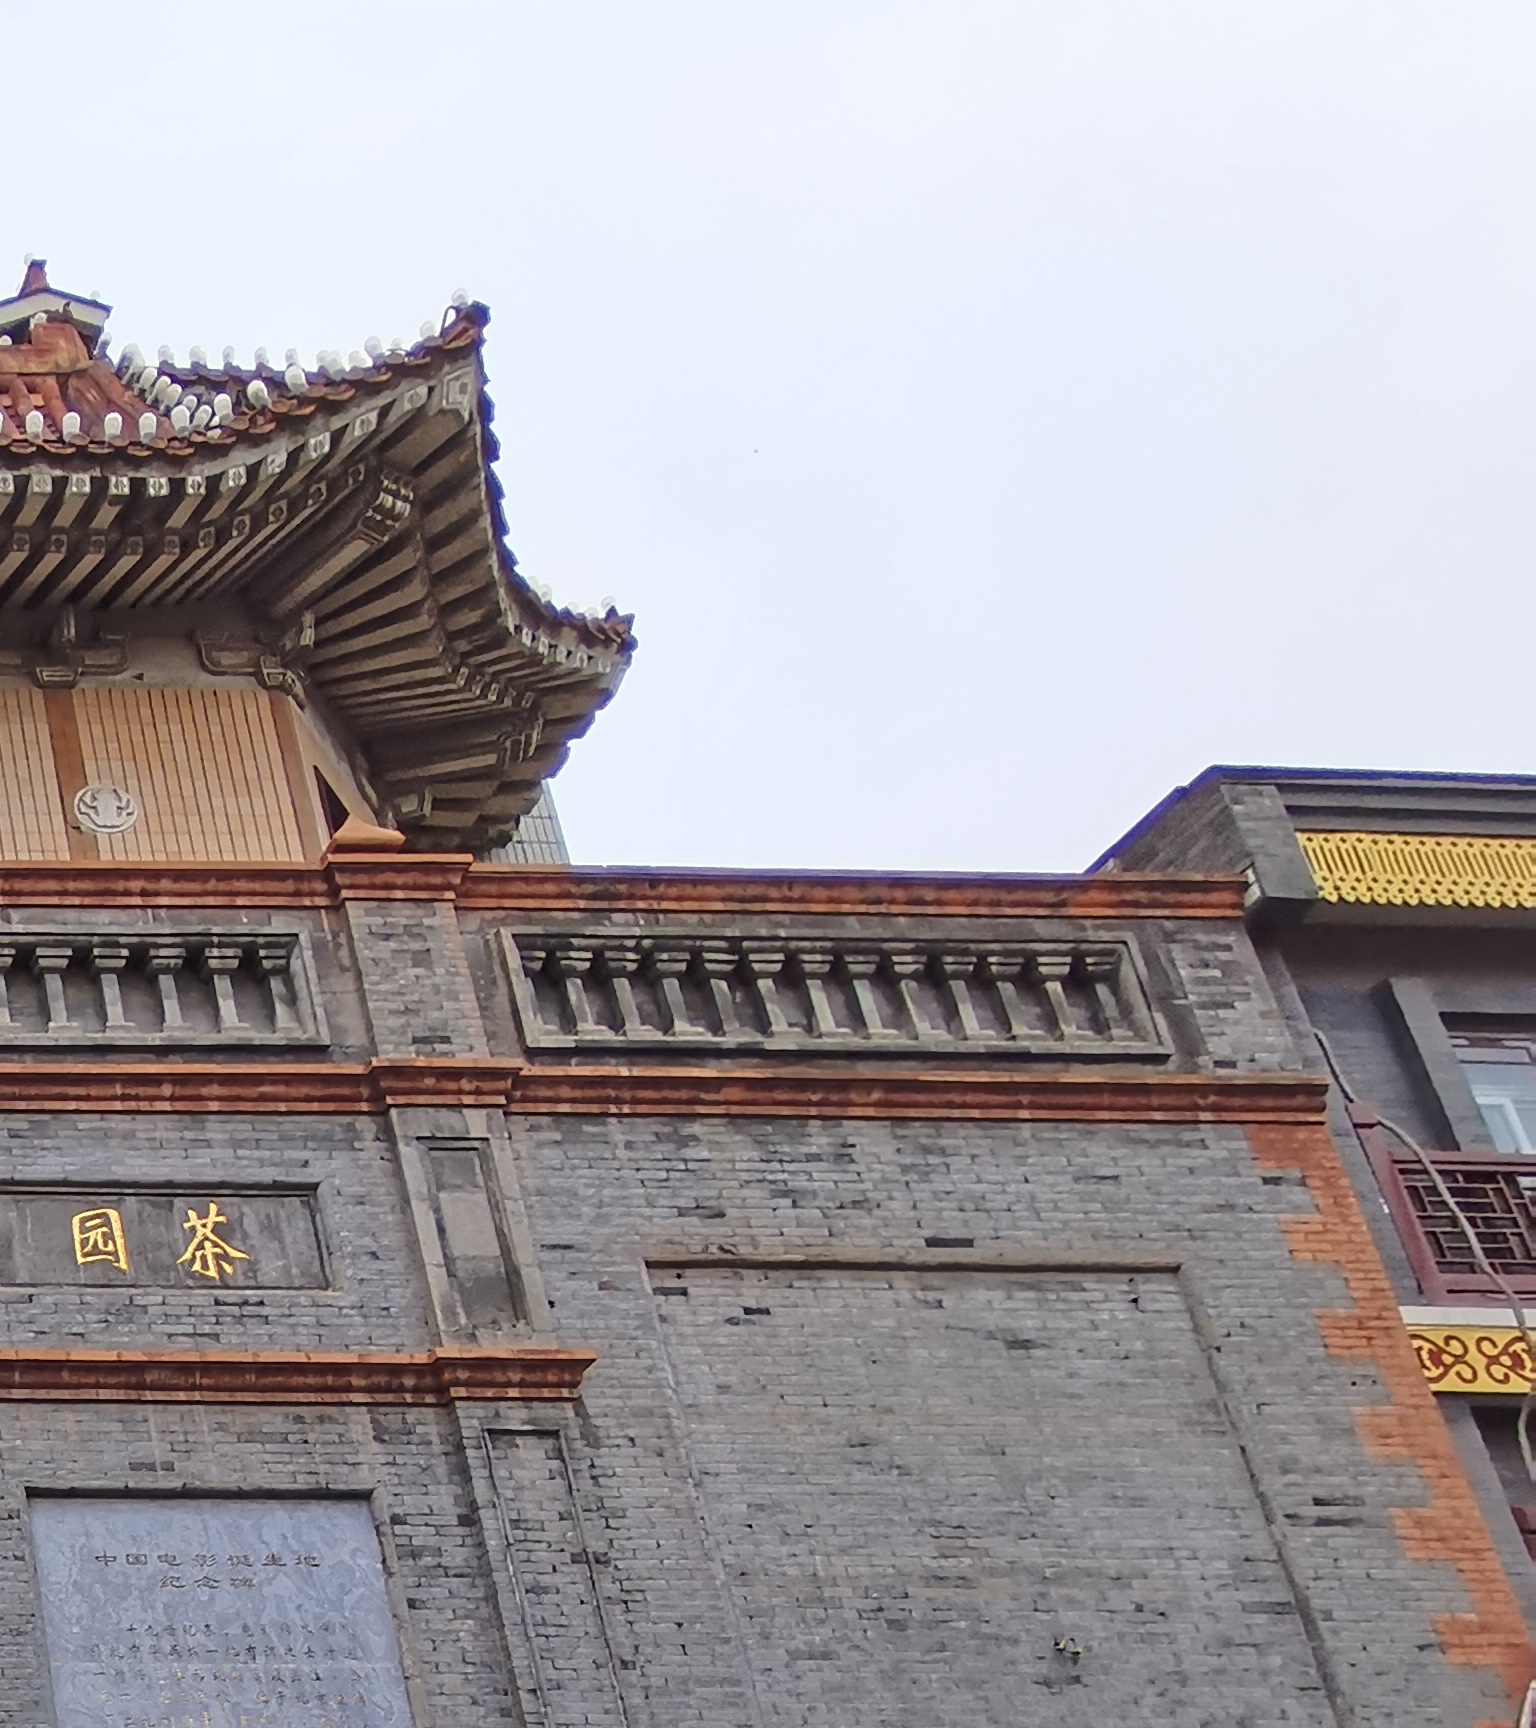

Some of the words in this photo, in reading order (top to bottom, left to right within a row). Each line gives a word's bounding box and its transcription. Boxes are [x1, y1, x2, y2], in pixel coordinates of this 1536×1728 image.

[72, 1203, 250, 1280] 茶园
[95, 1551, 321, 1567] 中国电影诞生地
